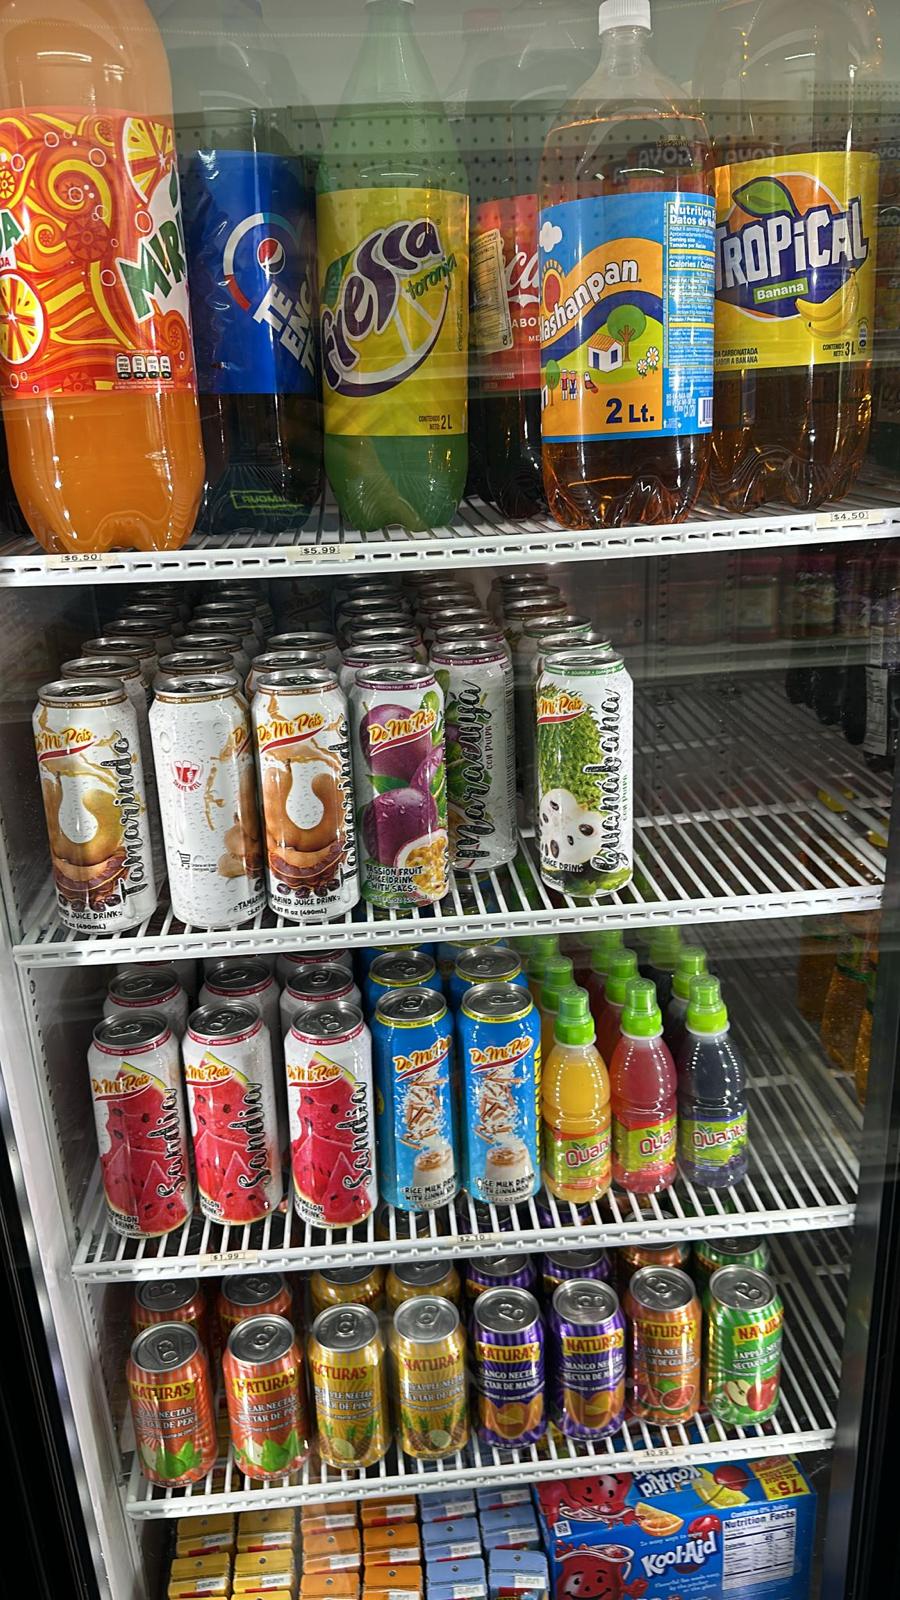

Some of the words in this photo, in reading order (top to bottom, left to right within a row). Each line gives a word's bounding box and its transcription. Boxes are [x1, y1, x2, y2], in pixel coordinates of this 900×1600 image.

[669, 204, 712, 217] Nutrition
[669, 214, 697, 225] Datos
[757, 281, 805, 301] Banana
[606, 398, 623, 424] 2
[833, 511, 866, 520] $4.50
[303, 546, 336, 555] $5.99
[64, 553, 98, 562] $6.50
[271, 721, 294, 738] Mi
[368, 725, 389, 742] De
[388, 720, 411, 737] Mi
[100, 730, 149, 903] Tamarindo
[366, 864, 397, 875] PASSION
[399, 865, 423, 875] FRUIT
[389, 876, 413, 884] DRINK
[294, 898, 314, 906] JUICE
[316, 895, 337, 904] DRINK
[71, 912, 92, 920] JUICE
[93, 911, 117, 919] DRINK
[486, 1047, 510, 1060] Mi
[394, 1056, 413, 1071] De
[213, 1253, 239, 1261] $1.99
[725, 1516, 766, 1529] Nutrition
[769, 1510, 795, 1521] Facts
[641, 1530, 717, 1577] Kool-Aid
